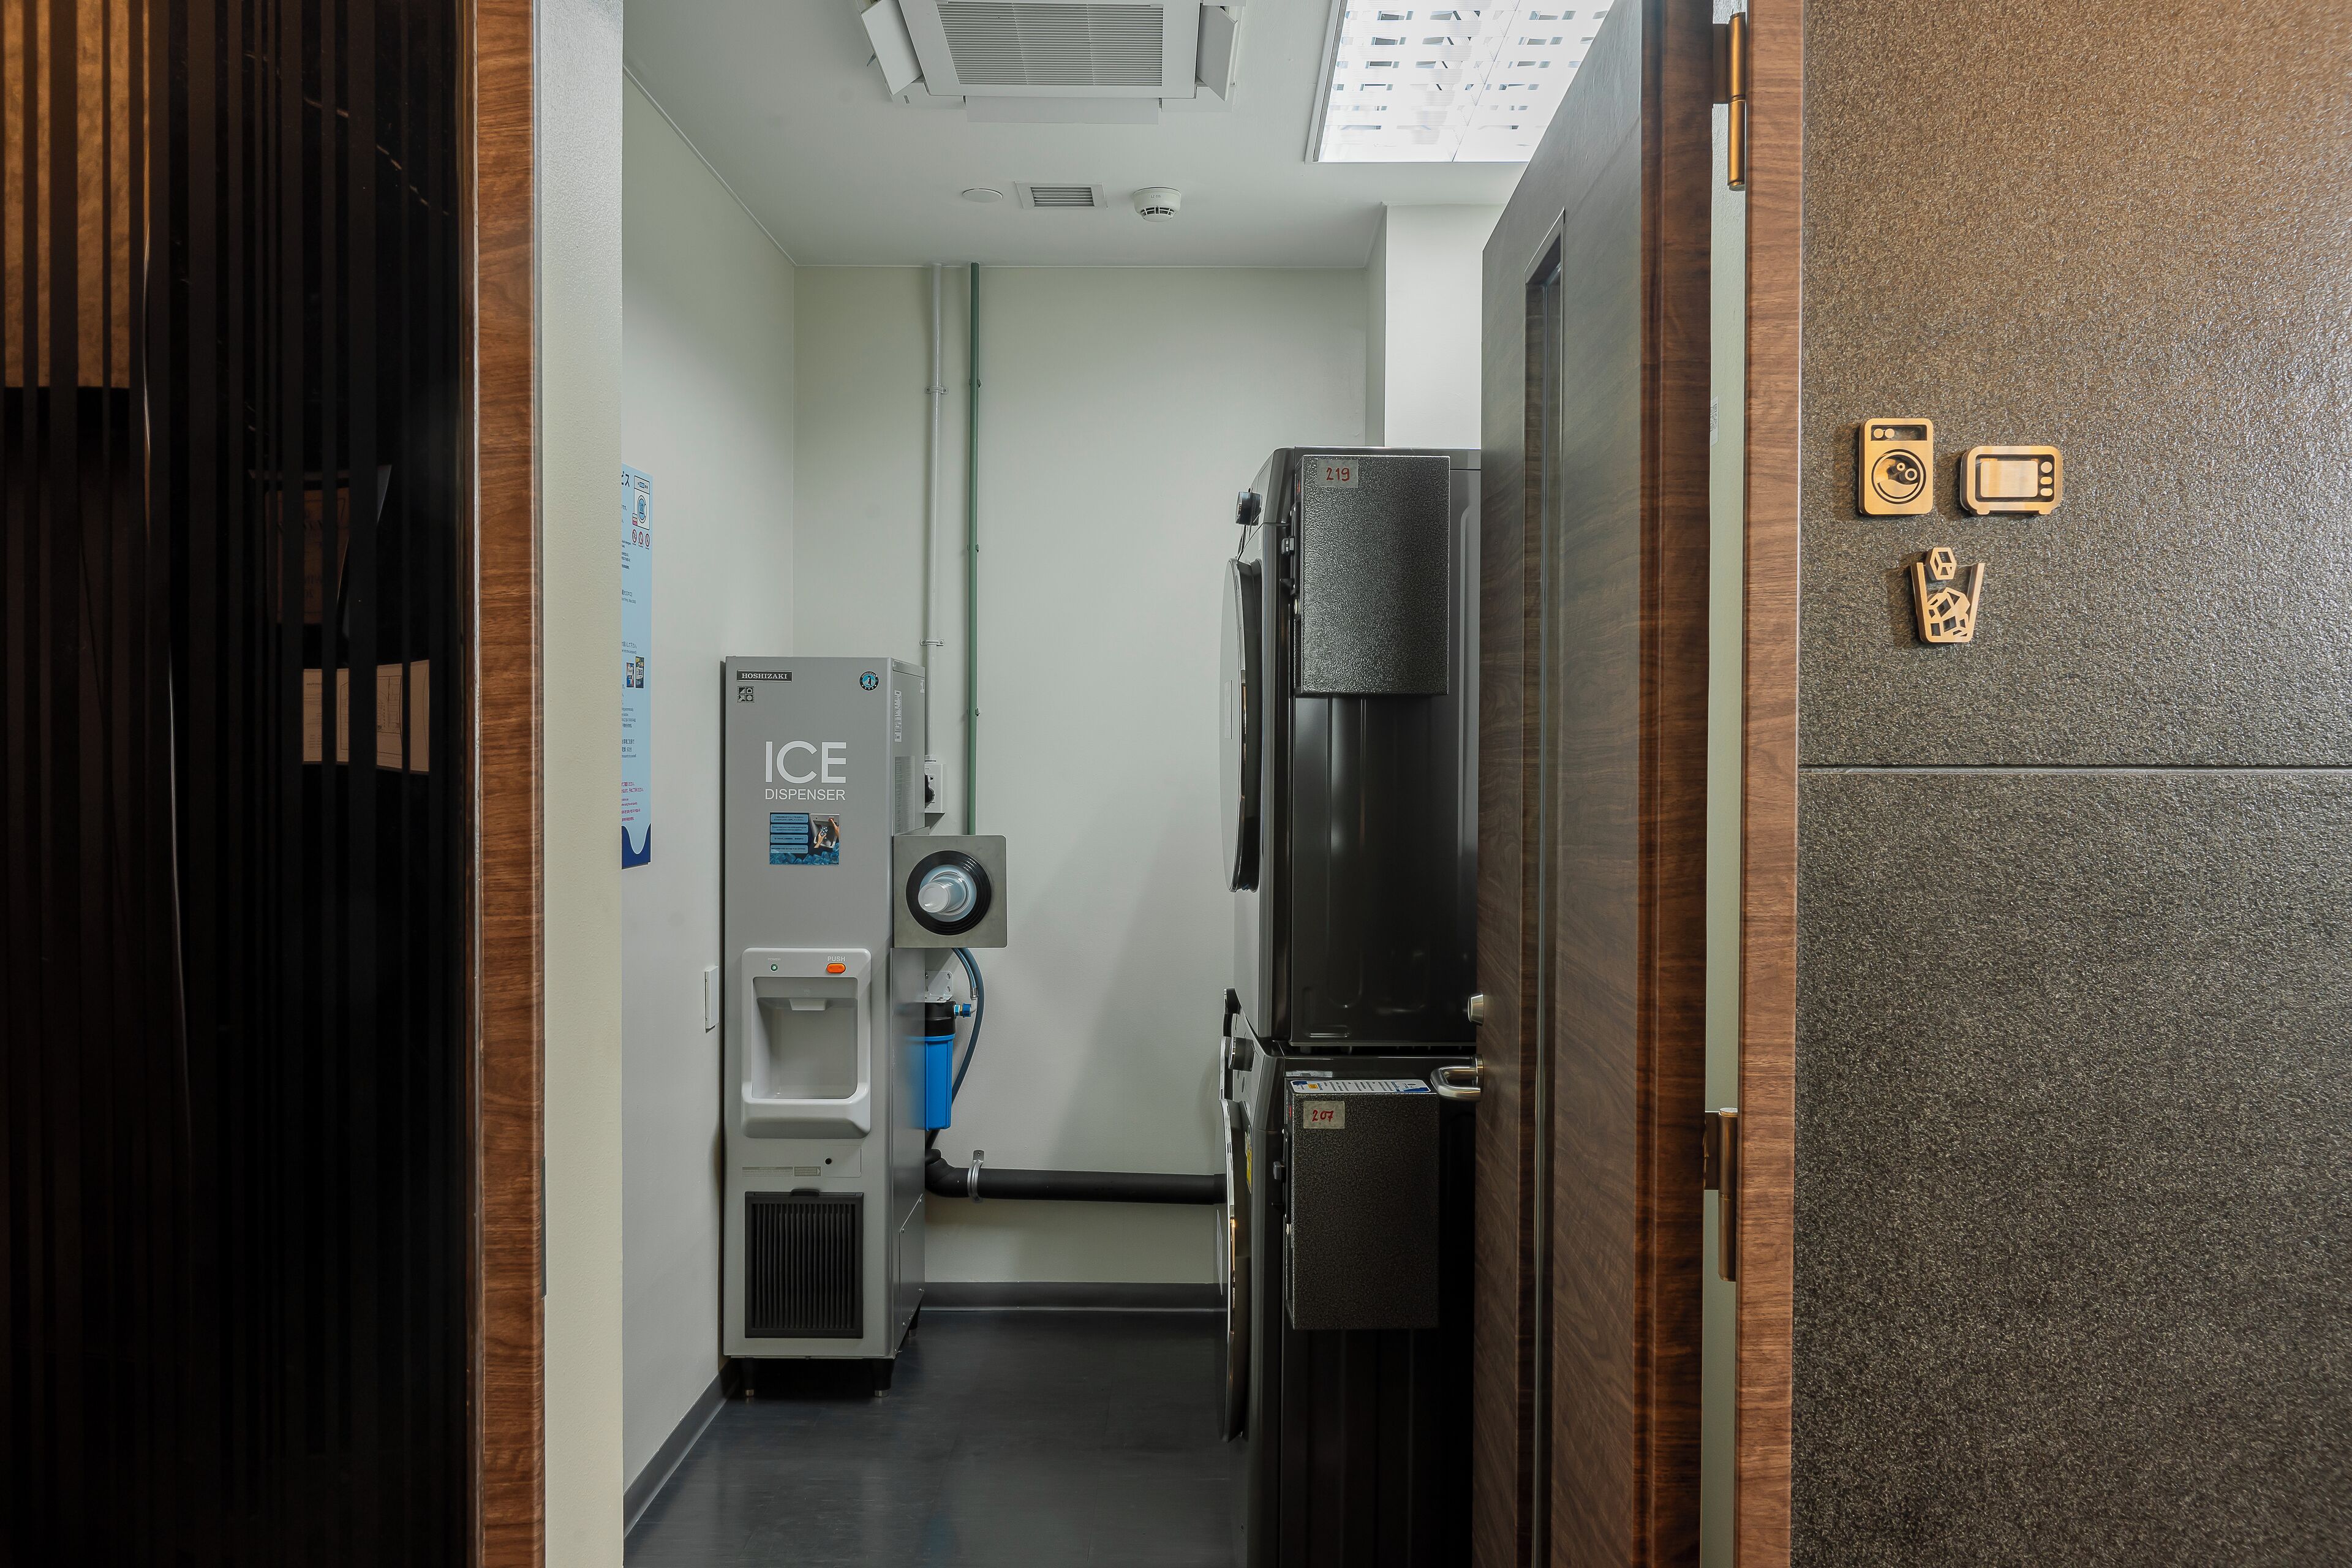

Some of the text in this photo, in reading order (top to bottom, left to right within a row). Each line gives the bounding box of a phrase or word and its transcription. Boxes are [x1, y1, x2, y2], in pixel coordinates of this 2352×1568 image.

[1326, 467, 1350, 481] 219
[766, 741, 846, 784] ICE
[765, 788, 846, 801] DISPENSER
[1311, 1109, 1334, 1122] 207
